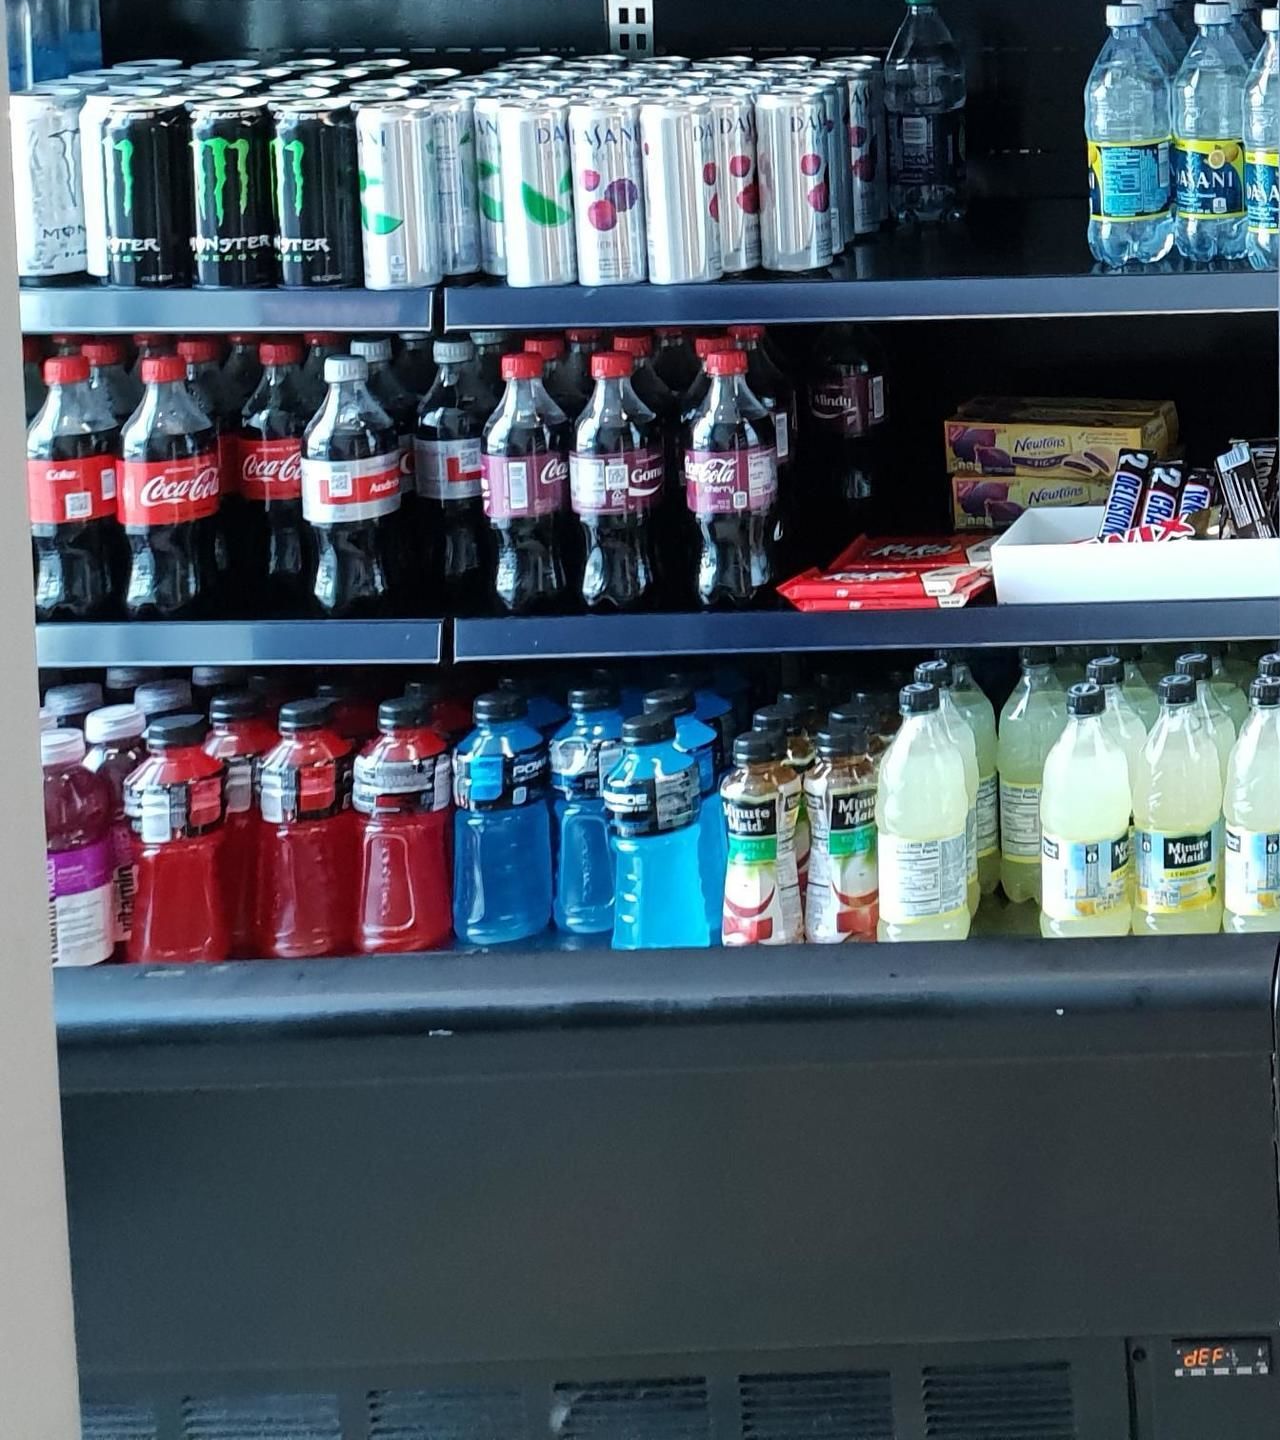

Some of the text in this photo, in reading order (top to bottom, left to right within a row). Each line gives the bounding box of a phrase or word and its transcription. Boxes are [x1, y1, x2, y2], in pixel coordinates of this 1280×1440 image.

[1014, 436, 1067, 455] Newtons
[1028, 486, 1084, 506] Newtons
[1168, 839, 1210, 857] Minute
[1174, 850, 1205, 866] Maid
